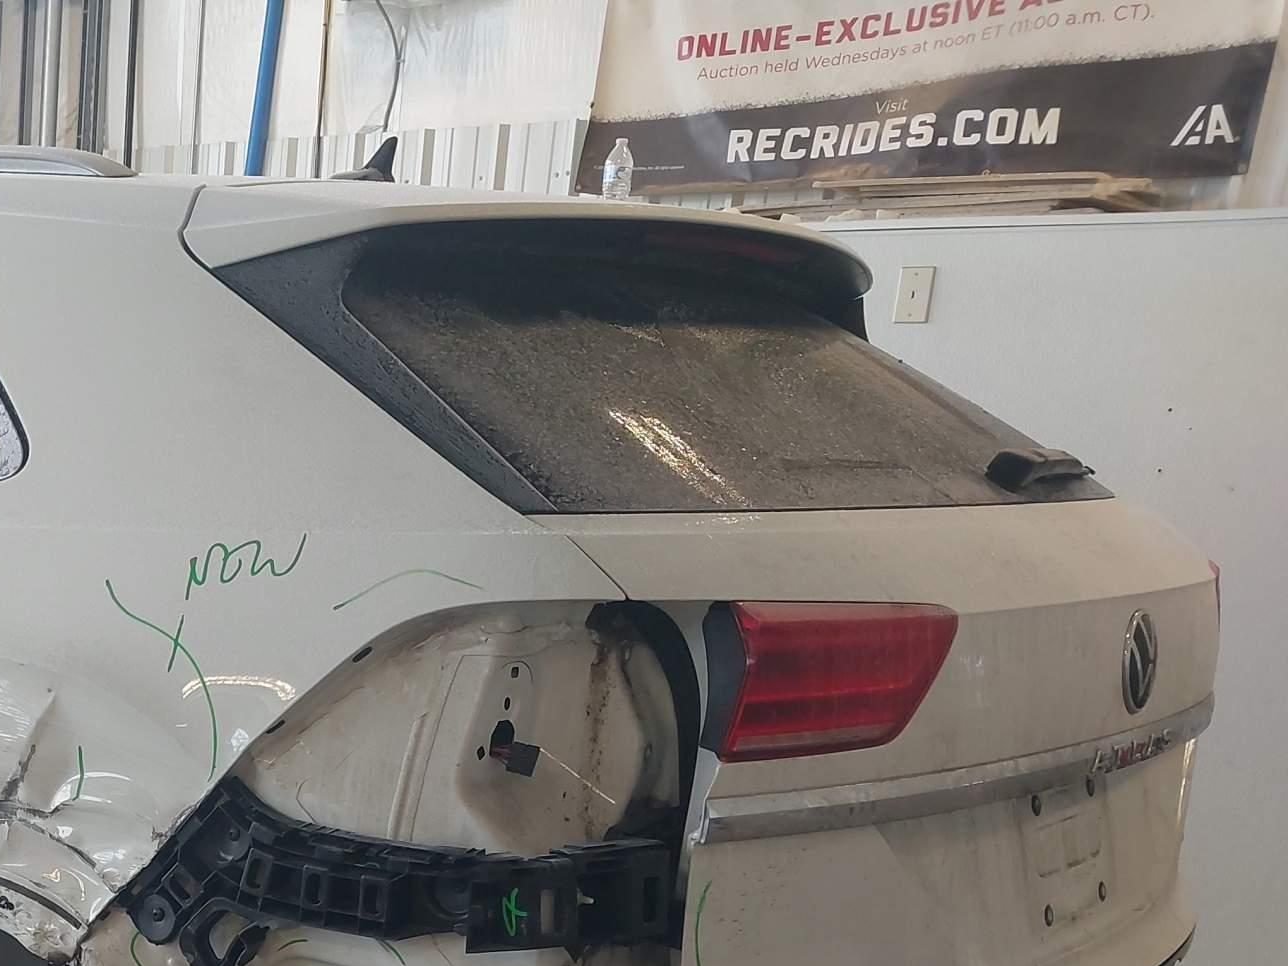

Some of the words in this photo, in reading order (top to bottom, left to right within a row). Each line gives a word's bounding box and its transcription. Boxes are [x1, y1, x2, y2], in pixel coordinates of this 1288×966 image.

[677, 0, 1006, 61] ONLINE-EXCLUSIVE
[697, 63, 759, 80] Auction
[764, 58, 799, 74] held
[805, 42, 907, 70] Wednesdays
[912, 40, 928, 54] at
[933, 32, 976, 51] noon
[981, 23, 1004, 41] ET
[1010, 12, 1060, 34] (11:00
[1065, 11, 1106, 26] a.m.
[726, 107, 1062, 163] RECRIDES.COM
[875, 99, 909, 115] Visit
